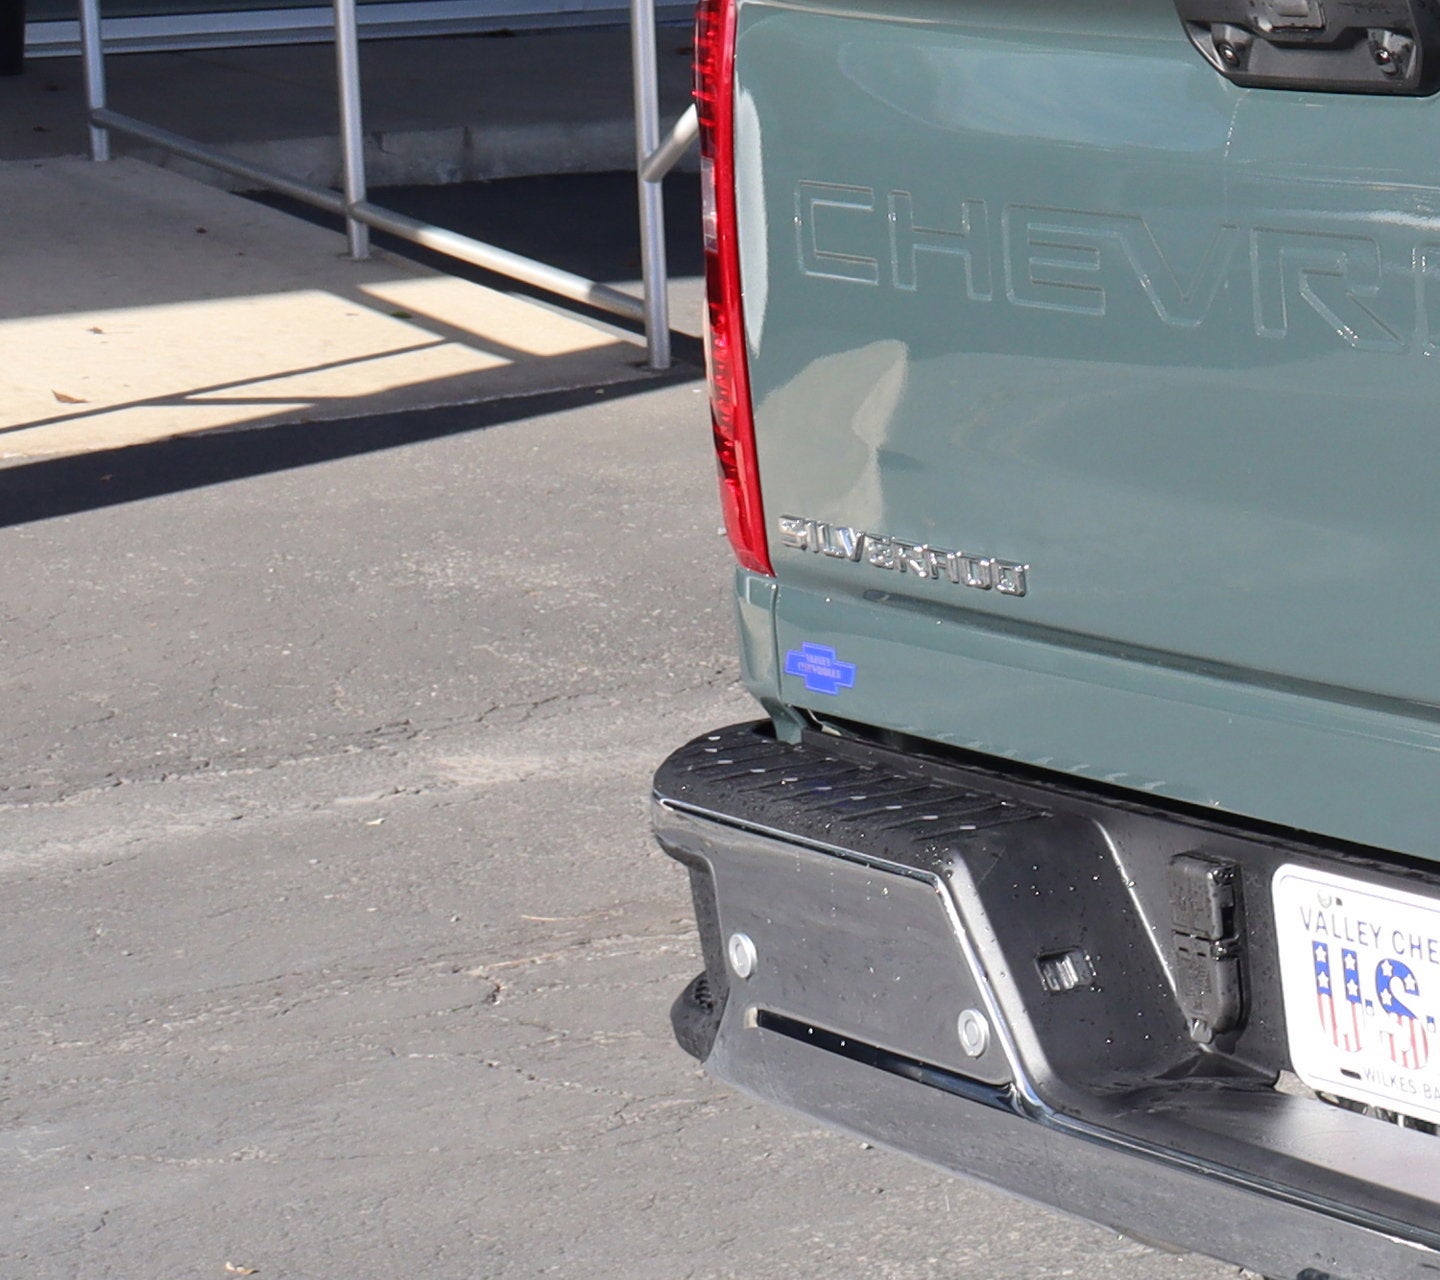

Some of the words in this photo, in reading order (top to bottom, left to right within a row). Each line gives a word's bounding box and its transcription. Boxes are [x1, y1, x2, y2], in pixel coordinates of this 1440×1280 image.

[778, 514, 1030, 598] SILVERADO
[1300, 906, 1382, 950] VALLEY
[1363, 1066, 1417, 1095] WILKES
